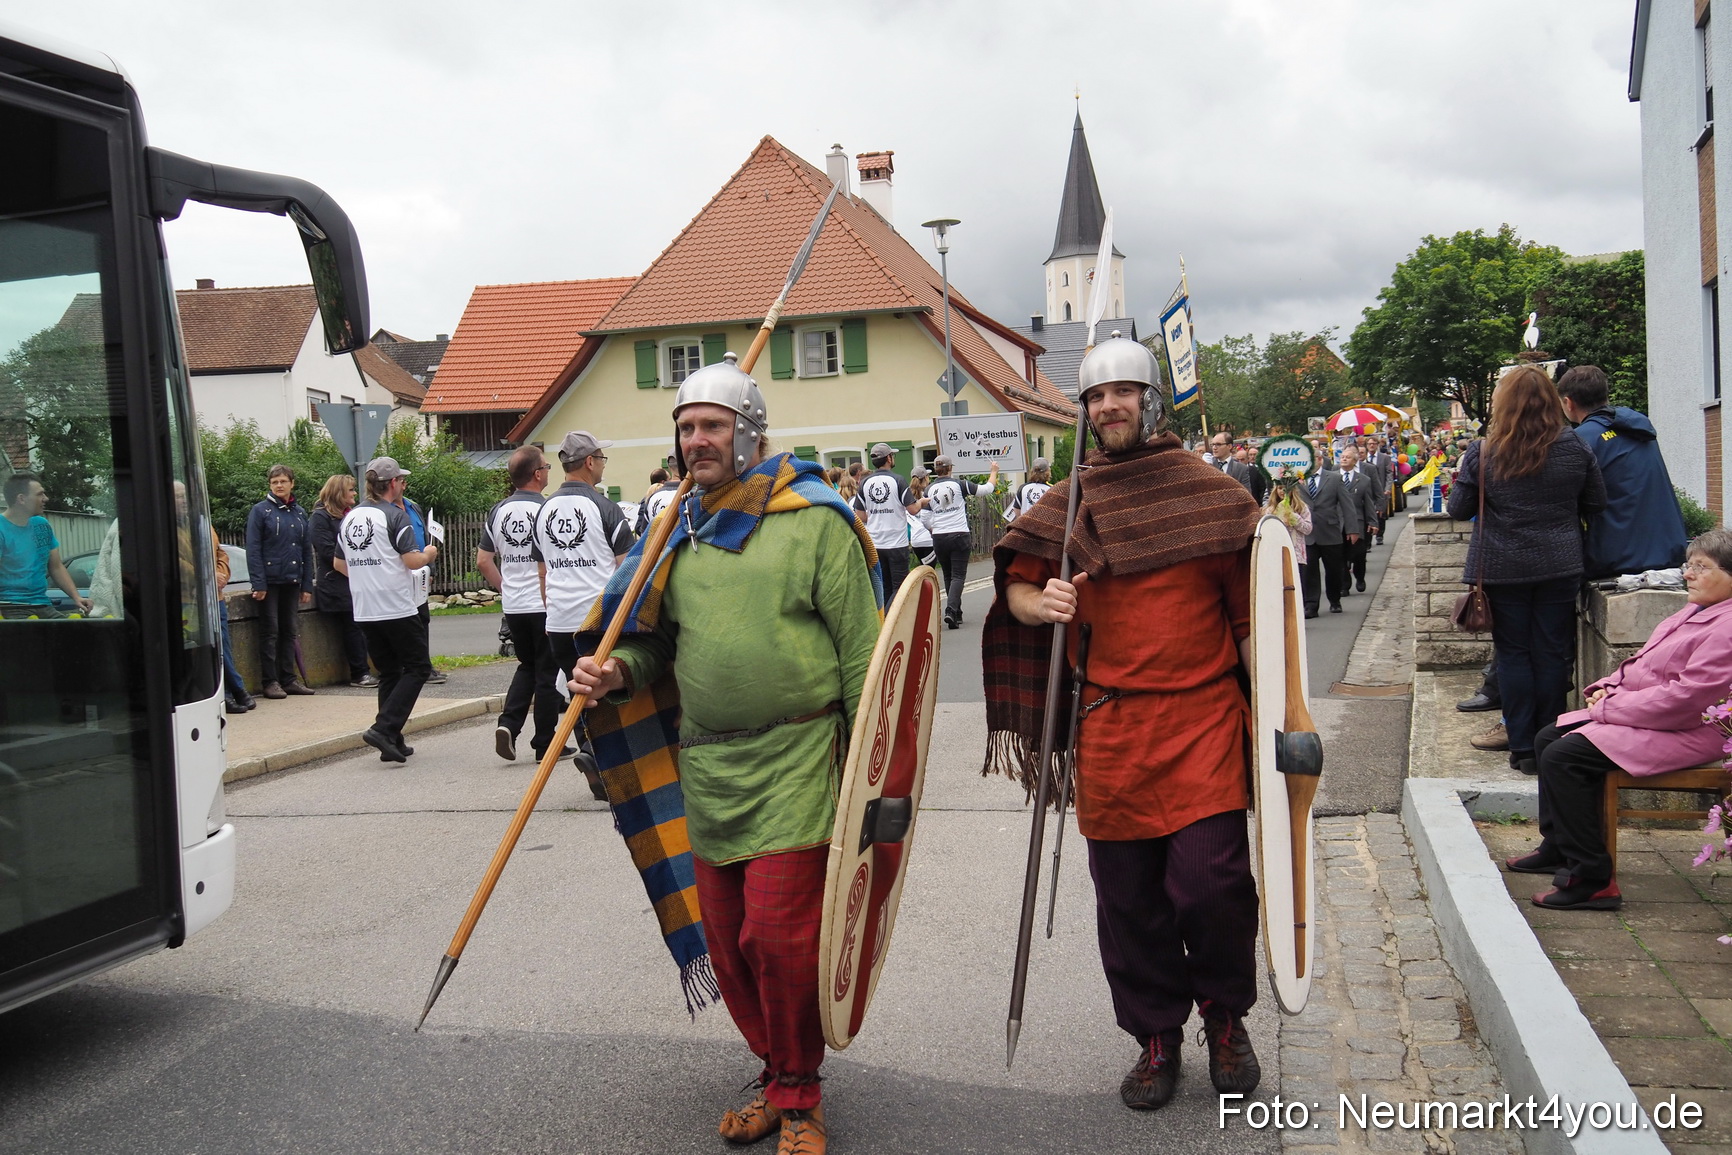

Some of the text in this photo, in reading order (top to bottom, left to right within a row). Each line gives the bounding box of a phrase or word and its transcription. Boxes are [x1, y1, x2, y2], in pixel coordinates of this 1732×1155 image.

[957, 449, 971, 458] der
[1272, 447, 1301, 457] VdK
[352, 524, 365, 538] 25.
[511, 520, 527, 534] 25.
[558, 518, 576, 534] 25.
